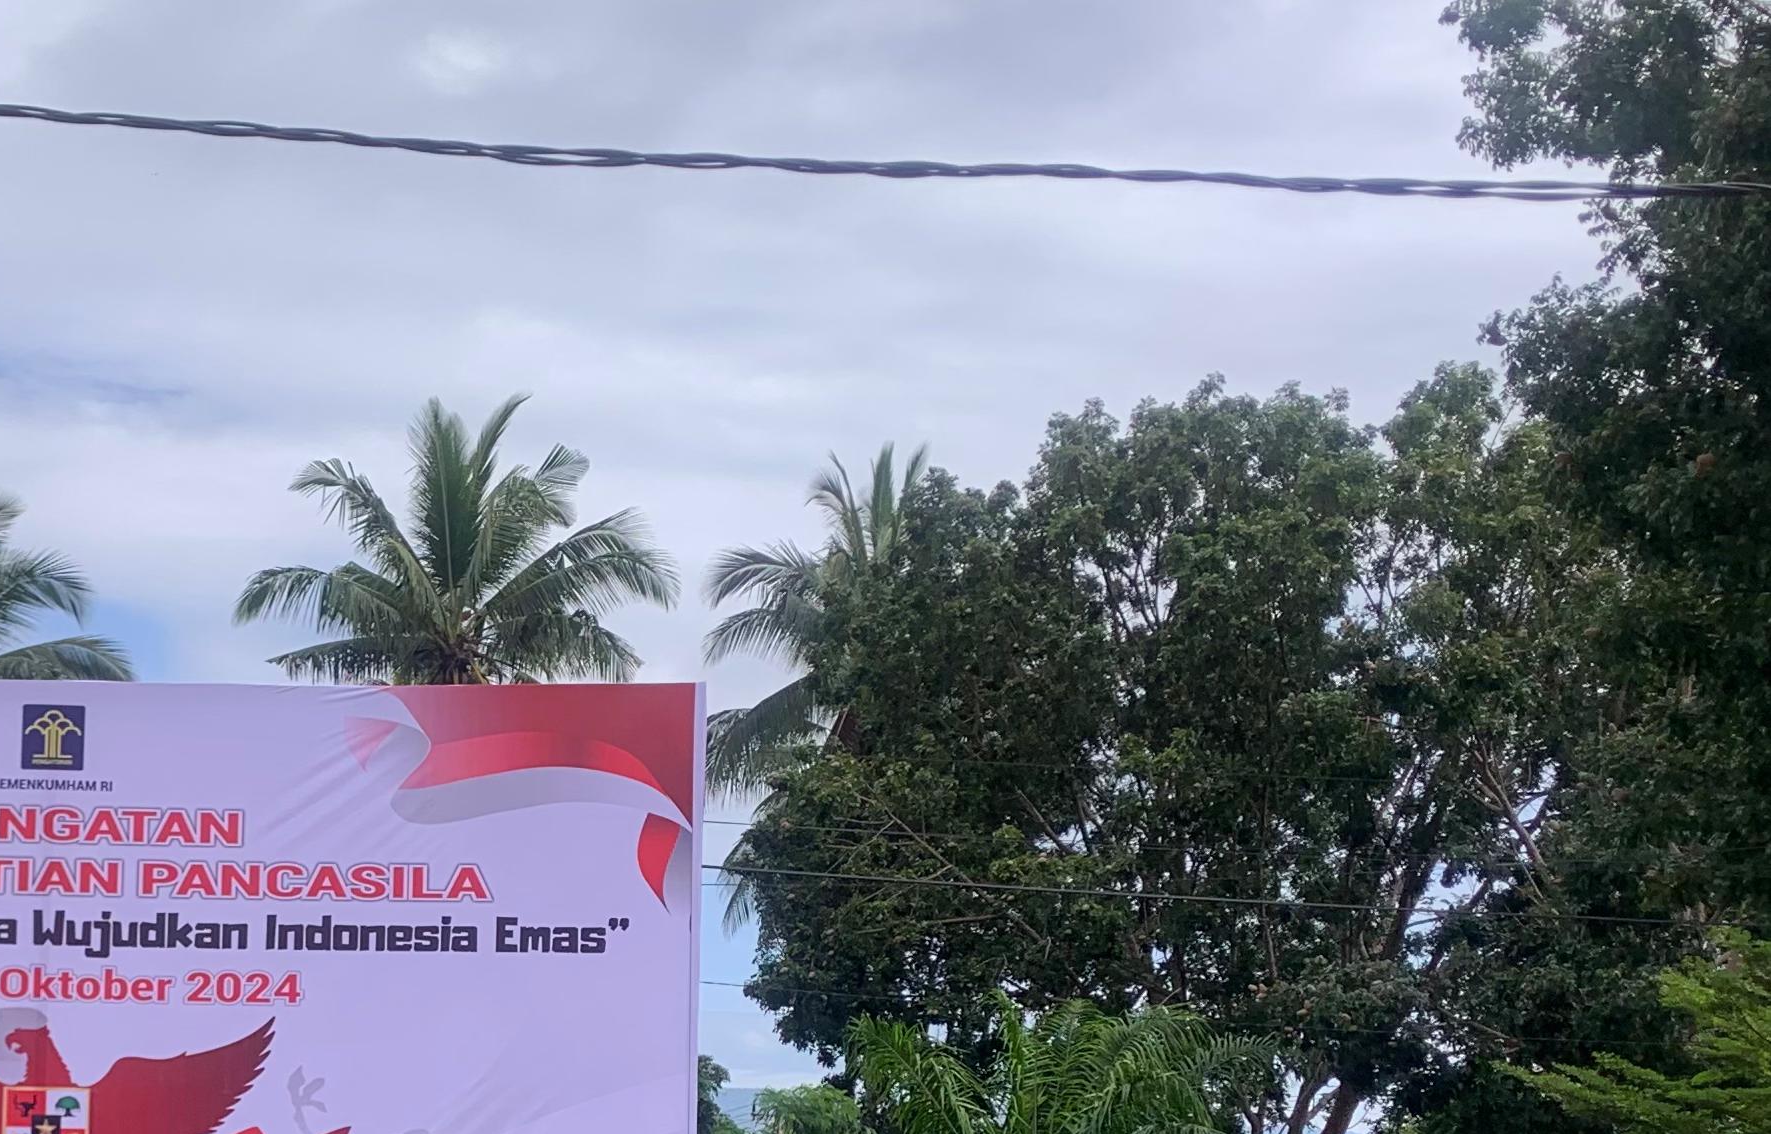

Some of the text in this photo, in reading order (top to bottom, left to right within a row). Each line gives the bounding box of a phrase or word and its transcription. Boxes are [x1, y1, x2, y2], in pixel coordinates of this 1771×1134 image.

[100, 781, 113, 792] RI
[139, 861, 489, 902] PANCASILA
[32, 909, 249, 959] Wujudkan
[265, 914, 478, 954] Indonesia
[185, 970, 302, 1006] 2024
